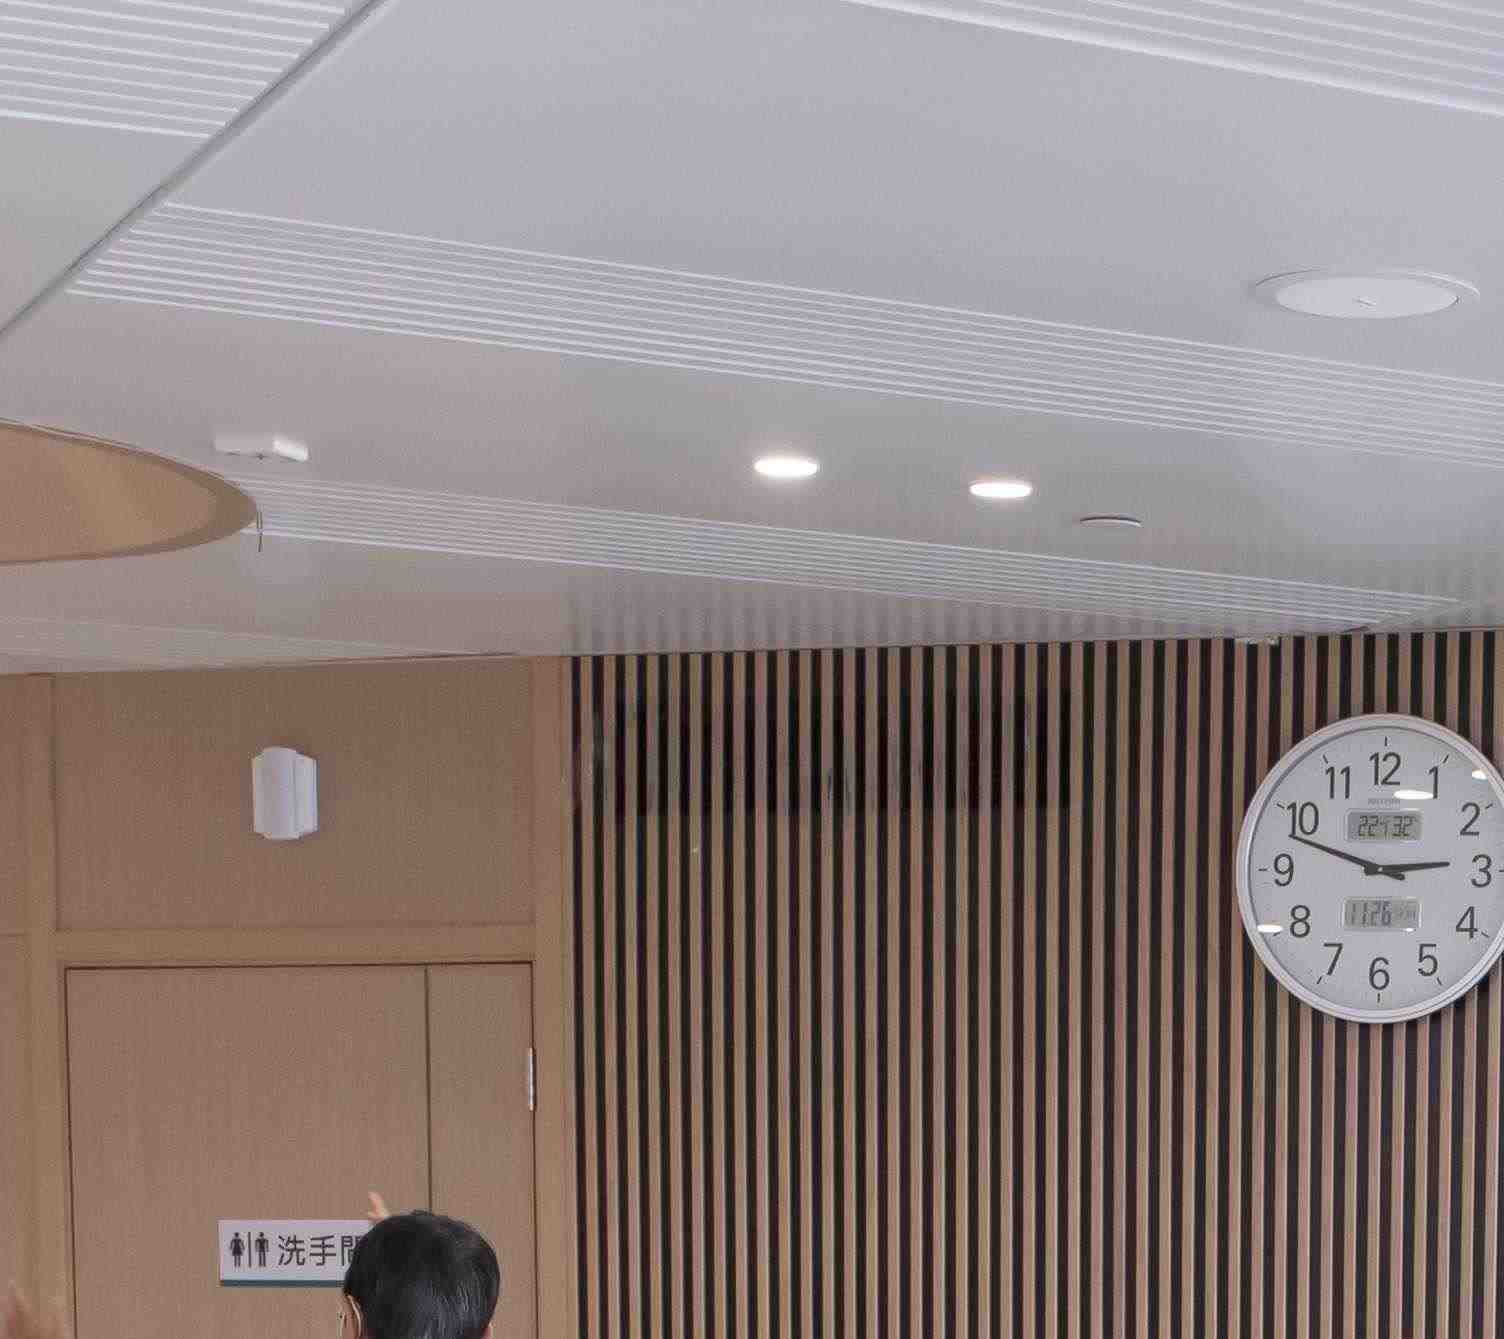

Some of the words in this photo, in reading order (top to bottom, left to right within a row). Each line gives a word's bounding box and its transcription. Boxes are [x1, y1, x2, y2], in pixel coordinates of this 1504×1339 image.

[1325, 766, 1351, 799] 11
[1369, 752, 1401, 786] 12
[1428, 766, 1439, 799] 1
[1286, 802, 1319, 835] 10
[1459, 802, 1480, 836] 2
[1274, 853, 1294, 887] 9
[1471, 854, 1492, 888] 3
[1290, 905, 1311, 938] 8
[1456, 906, 1478, 939] 4
[1324, 943, 1344, 976] 7
[1369, 957, 1390, 991] 6
[1418, 943, 1438, 977] 5
